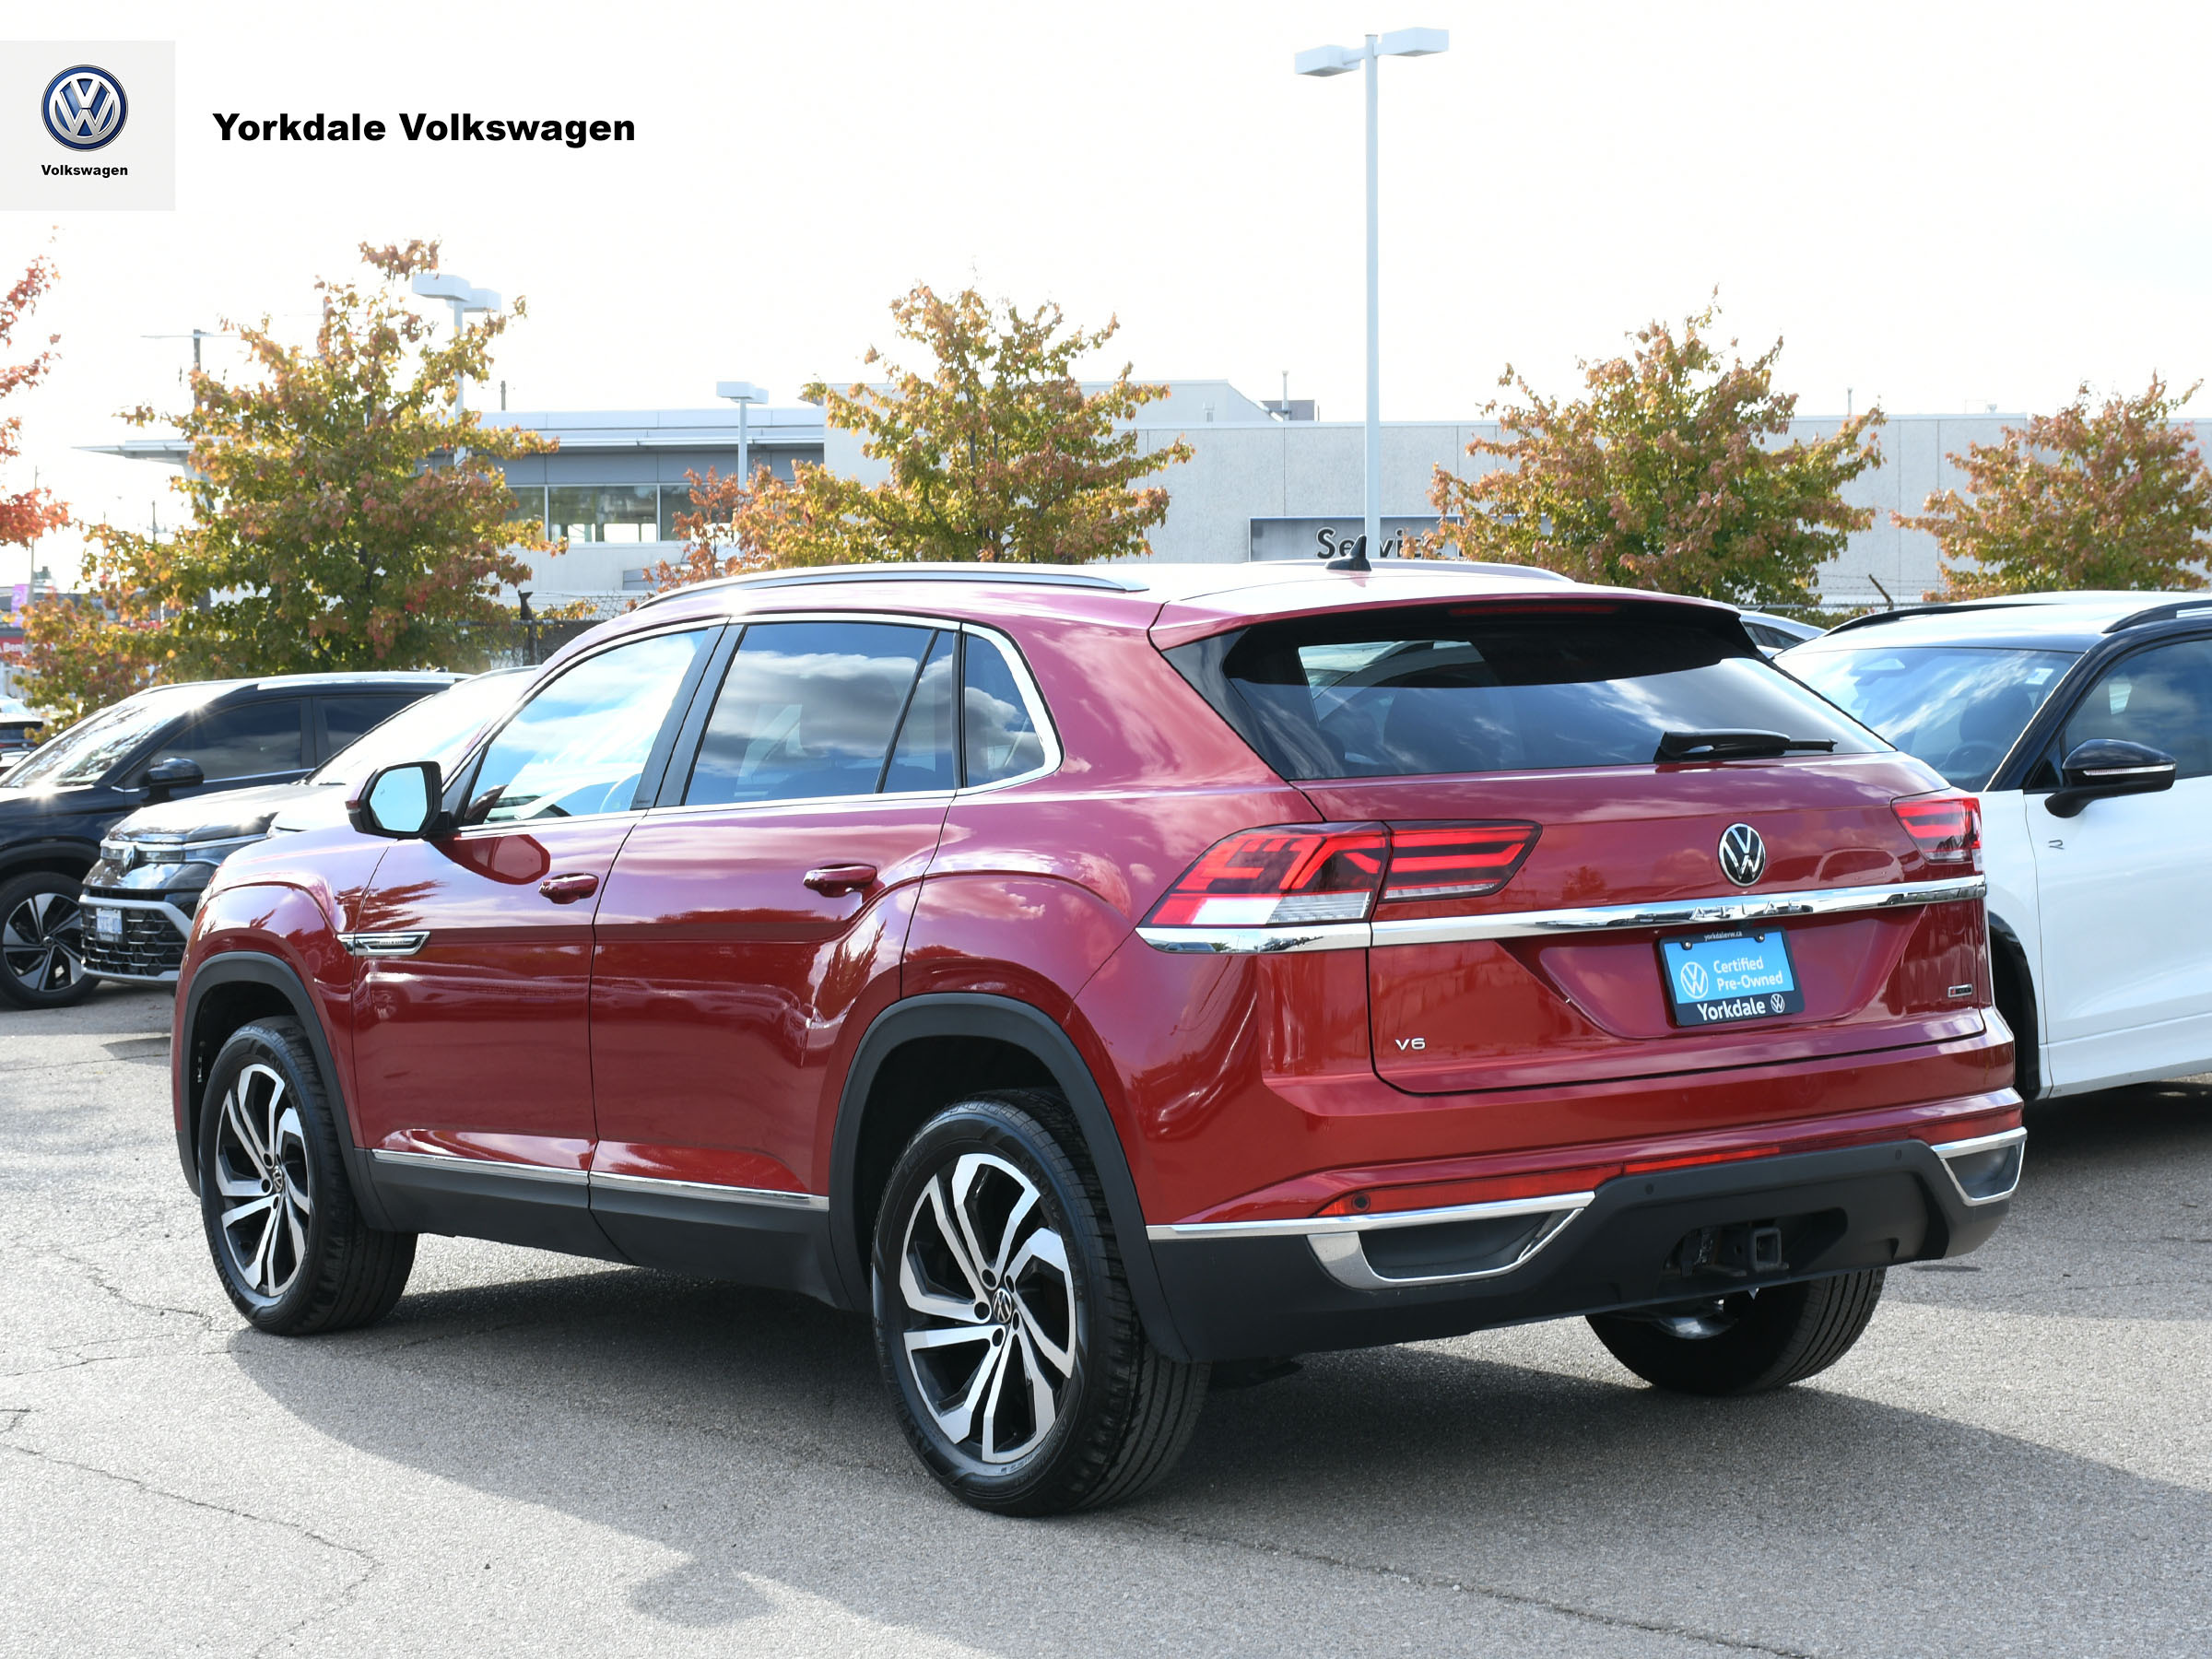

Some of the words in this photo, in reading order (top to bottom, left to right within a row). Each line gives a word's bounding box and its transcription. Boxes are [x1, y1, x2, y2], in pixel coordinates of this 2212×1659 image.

[1713, 956, 1764, 974] Certified
[1717, 971, 1783, 992] Pre-Owned
[1697, 997, 1766, 1021] Yorkdale
[1394, 1038, 1426, 1051] V6
